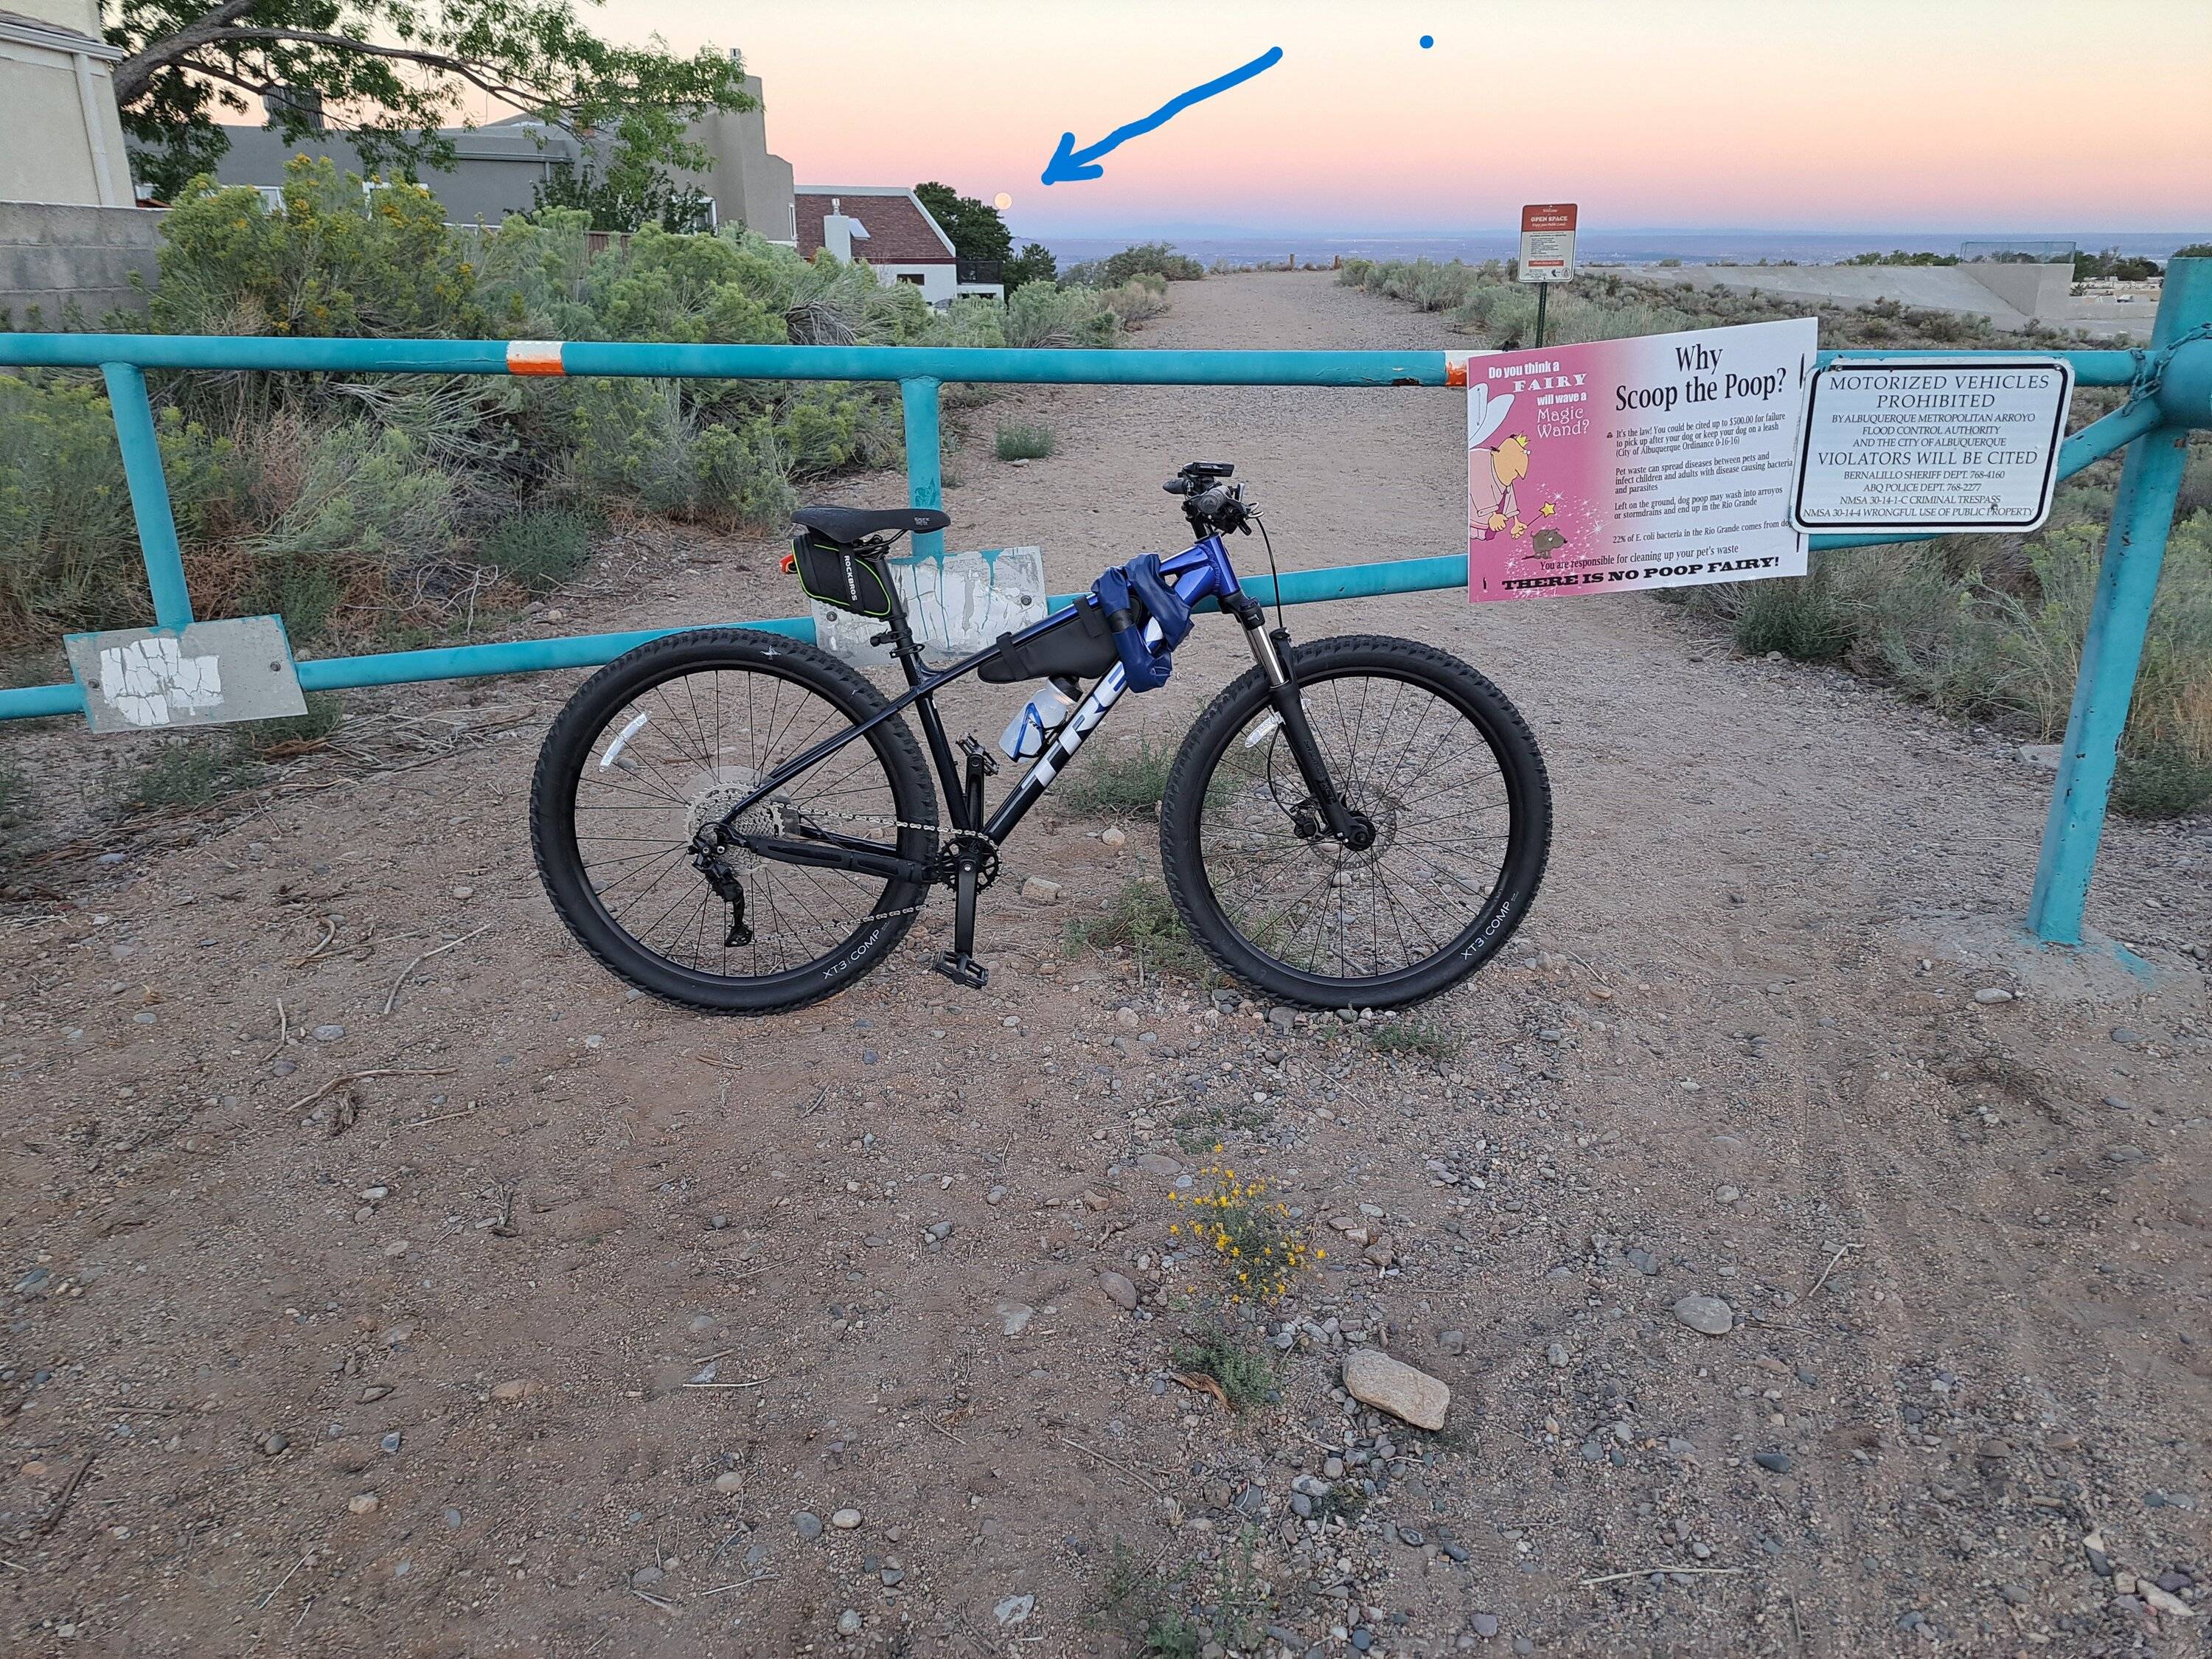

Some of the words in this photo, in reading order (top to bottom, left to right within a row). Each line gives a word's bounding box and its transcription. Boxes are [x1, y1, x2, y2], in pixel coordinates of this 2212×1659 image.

[1675, 344, 1722, 373] Why
[1489, 366, 1502, 379] Do
[1503, 365, 1522, 379] you
[1524, 360, 1551, 375] think
[1553, 361, 1559, 372] a
[1512, 374, 1586, 392] FAIRY
[1615, 385, 1677, 411] Scoop
[1686, 376, 1717, 403] the
[1725, 367, 1786, 400] Poop?
[1829, 376, 1946, 390] MOTORIZED
[1954, 375, 2048, 389] VEHICLES
[1537, 392, 1554, 406] will
[1555, 392, 1579, 404] wave
[1580, 391, 1586, 401] a
[1877, 394, 1994, 408] PROHIBITED
[1537, 407, 1583, 423] Magic
[1832, 414, 1843, 422] BY
[1844, 414, 1916, 425] ALBUQUERQUE
[1918, 414, 1992, 422] METROPOLITAN
[1994, 414, 2034, 422] ARROYO
[1537, 420, 1589, 437] Wand?
[1616, 428, 1626, 438] It's
[1627, 427, 1638, 437] the
[1639, 425, 1652, 435] law!
[1654, 425, 1665, 434] You
[1667, 422, 1684, 432] could
[1686, 421, 1694, 431] be
[1695, 419, 1710, 429] cited
[1712, 420, 1719, 428] up
[1730, 414, 1753, 425] $500.00
[1755, 414, 1764, 423] for
[1766, 412, 1785, 422] failure
[1616, 439, 1622, 448] to
[1624, 437, 1638, 448] pick
[1639, 438, 1647, 446] up
[1649, 434, 1663, 444] after
[1666, 434, 1680, 444] your
[1681, 431, 1693, 441] dog
[1703, 429, 1718, 438] keep
[1719, 428, 1733, 438] your
[1735, 425, 1746, 435] dog
[1763, 421, 1778, 431] leash
[1862, 426, 1894, 435] FLOOD
[1896, 426, 1942, 435] CONTROL
[1944, 426, 2000, 435] AUTHORITY
[1615, 447, 1630, 458] (City
[1632, 445, 1639, 454] of
[1641, 444, 1680, 454] Albuquerque
[1682, 439, 1714, 450] Ordinance
[1852, 439, 1874, 447] AND
[1876, 438, 1895, 447] THE
[1897, 438, 1919, 447] CITY
[1920, 438, 1933, 447] OF
[1934, 438, 2006, 448] ALBUQUERQUE
[1615, 466, 1625, 476] Pet
[1627, 465, 1646, 474] waste
[1661, 460, 1683, 472] spread
[1685, 459, 1712, 469] diseases
[1714, 457, 1740, 466] between
[1742, 455, 1756, 465] pets
[1757, 452, 1769, 462] and
[1817, 451, 1910, 465] VIOLATORS
[1916, 451, 1957, 465] WILL
[1962, 451, 1981, 465] BE
[1986, 451, 2037, 465] CITED
[1615, 475, 1633, 484] infect
[1635, 472, 1662, 482] children
[1664, 470, 1676, 479] and
[1677, 468, 1698, 478] adults
[1700, 466, 1714, 476] with
[1716, 465, 1739, 474] disease
[1741, 461, 1765, 472] causing
[1767, 458, 1792, 469] bacteria
[1843, 470, 1902, 479] BERNALILLO
[1903, 470, 1941, 479] SHERIFF
[1943, 470, 1967, 479] DEPT.
[1969, 470, 2004, 479] 768-4160
[1615, 485, 1627, 495] and
[1629, 483, 1658, 495] parasites
[1863, 484, 1883, 494] ABQ
[1885, 483, 1918, 492] POLICE
[1920, 483, 1944, 492] DEPT.
[1947, 483, 1980, 492] 768-2277
[1615, 501, 1627, 510] Left
[1639, 498, 1649, 508] the
[1651, 496, 1675, 508] ground,
[1677, 495, 1690, 505] dog
[1691, 495, 1708, 504] poop
[1710, 493, 1723, 501] may
[1725, 489, 1742, 499] wash
[1743, 489, 1756, 498] into
[1758, 487, 1782, 496] arroyos
[1623, 507, 1661, 518] stormdrains
[1663, 504, 1675, 515] and
[1677, 503, 1689, 513] end
[1691, 504, 1700, 513] up
[1702, 501, 1708, 511] in
[1710, 501, 1719, 510] the
[1722, 500, 1732, 509] Rio
[1734, 497, 1757, 508] Grande
[1840, 495, 1867, 504] NMSA
[1869, 495, 1907, 504] 30-14-1-C
[1908, 495, 1955, 504] CRIMINAL
[1957, 495, 2000, 504] TRESPASS
[1803, 509, 1830, 517] NMSA
[1832, 508, 1860, 517] 30-14-4
[1863, 508, 1916, 517] WRONGFUL
[1919, 508, 1935, 517] USE
[1937, 508, 1950, 517] OF
[1952, 508, 1984, 517] PUBLIC
[1986, 508, 2034, 517] PROPERTY
[1613, 534, 1625, 543] 22%
[1627, 532, 1634, 542] of
[1635, 532, 1641, 541] E.
[1643, 531, 1655, 540] coli
[1656, 529, 1682, 540] bacteria
[1683, 528, 1690, 537] in
[1692, 526, 1703, 536] the
[1704, 526, 1715, 535] Rio
[1717, 524, 1739, 534] Grande
[1741, 524, 1761, 532] comes
[1763, 521, 1778, 529] from
[1540, 559, 1554, 569] You
[1557, 560, 1568, 568] are
[1571, 554, 1614, 568] responsible
[1616, 553, 1628, 563] for
[1630, 550, 1661, 562] cleaning
[1663, 551, 1674, 560] up
[1676, 549, 1694, 560] your
[1696, 545, 1714, 558] pet's
[1717, 544, 1738, 554] waste
[844, 555, 858, 601] ROCKBROS
[1501, 574, 1578, 590] THERE
[1582, 572, 1604, 583] IS
[1607, 569, 1639, 580] NO
[1643, 564, 1703, 577] POOP
[1707, 557, 1778, 572] FAIRY!
[1020, 656, 1130, 788] TRE
[1461, 937, 1485, 960] XT3
[1485, 901, 1510, 936] COMP
[823, 960, 847, 980] XT3
[850, 929, 880, 961] COMP
